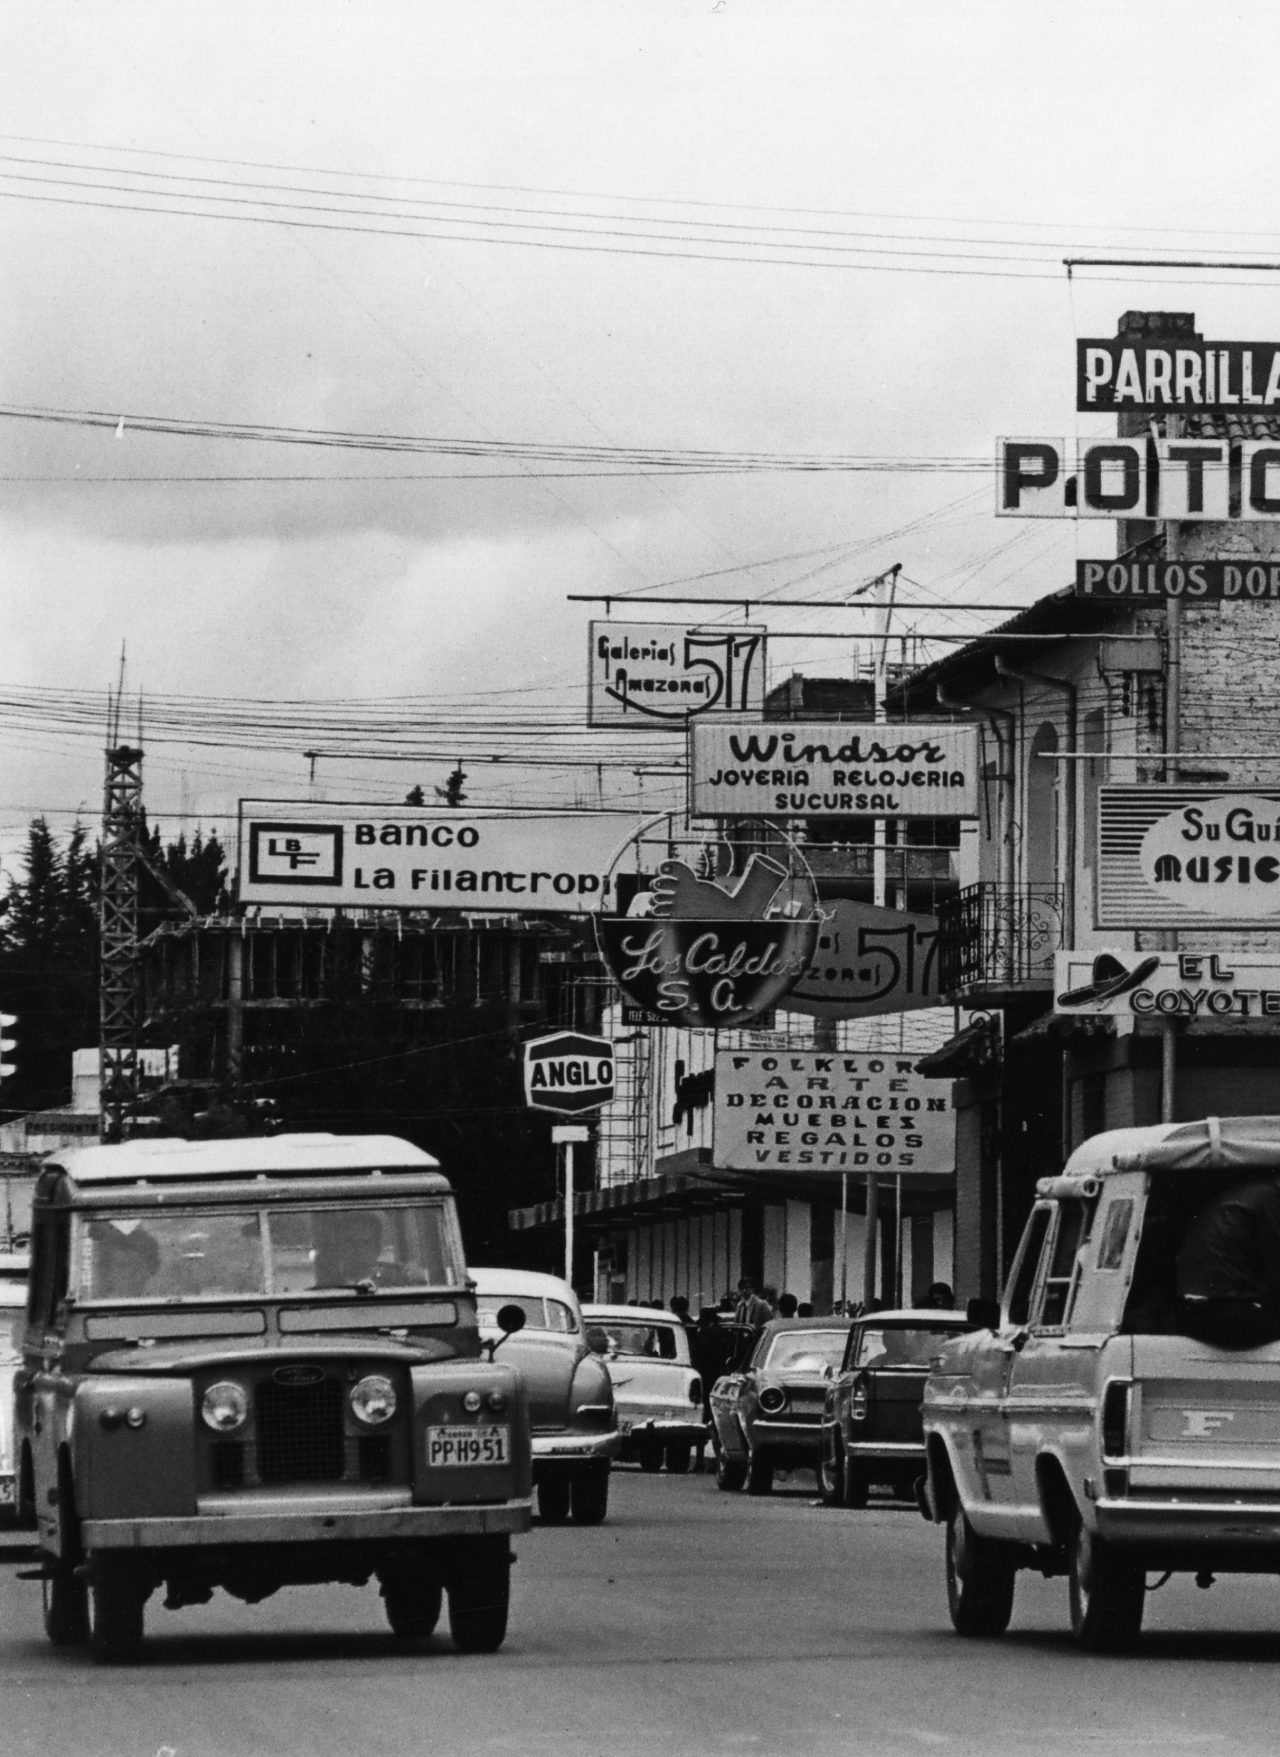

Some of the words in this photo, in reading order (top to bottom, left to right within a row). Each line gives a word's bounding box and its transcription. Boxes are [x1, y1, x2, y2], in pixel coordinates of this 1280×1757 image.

[1084, 563, 1208, 596] POLLOS
[598, 635, 675, 679] Galerias
[605, 634, 760, 719] 517
[615, 668, 711, 713] Amazonas
[729, 733, 946, 763] Windsor
[709, 770, 809, 787] JOYERIA
[833, 770, 965, 787] RELOJERIA
[775, 793, 900, 810] SUCURSAL
[354, 824, 480, 848] Banco
[1181, 808, 1220, 841] Su
[354, 868, 396, 889] La
[411, 869, 616, 895] Filantropi
[1178, 954, 1234, 980] EL
[531, 1060, 613, 1088] ANGLO
[732, 1057, 914, 1074] FOLKLOR
[765, 1076, 909, 1092] ARTE
[727, 1094, 947, 1112] DECORACION
[755, 1113, 916, 1130] MUEBLES
[747, 1131, 923, 1149] REGALOS
[756, 1151, 914, 1167] VESTIDOS
